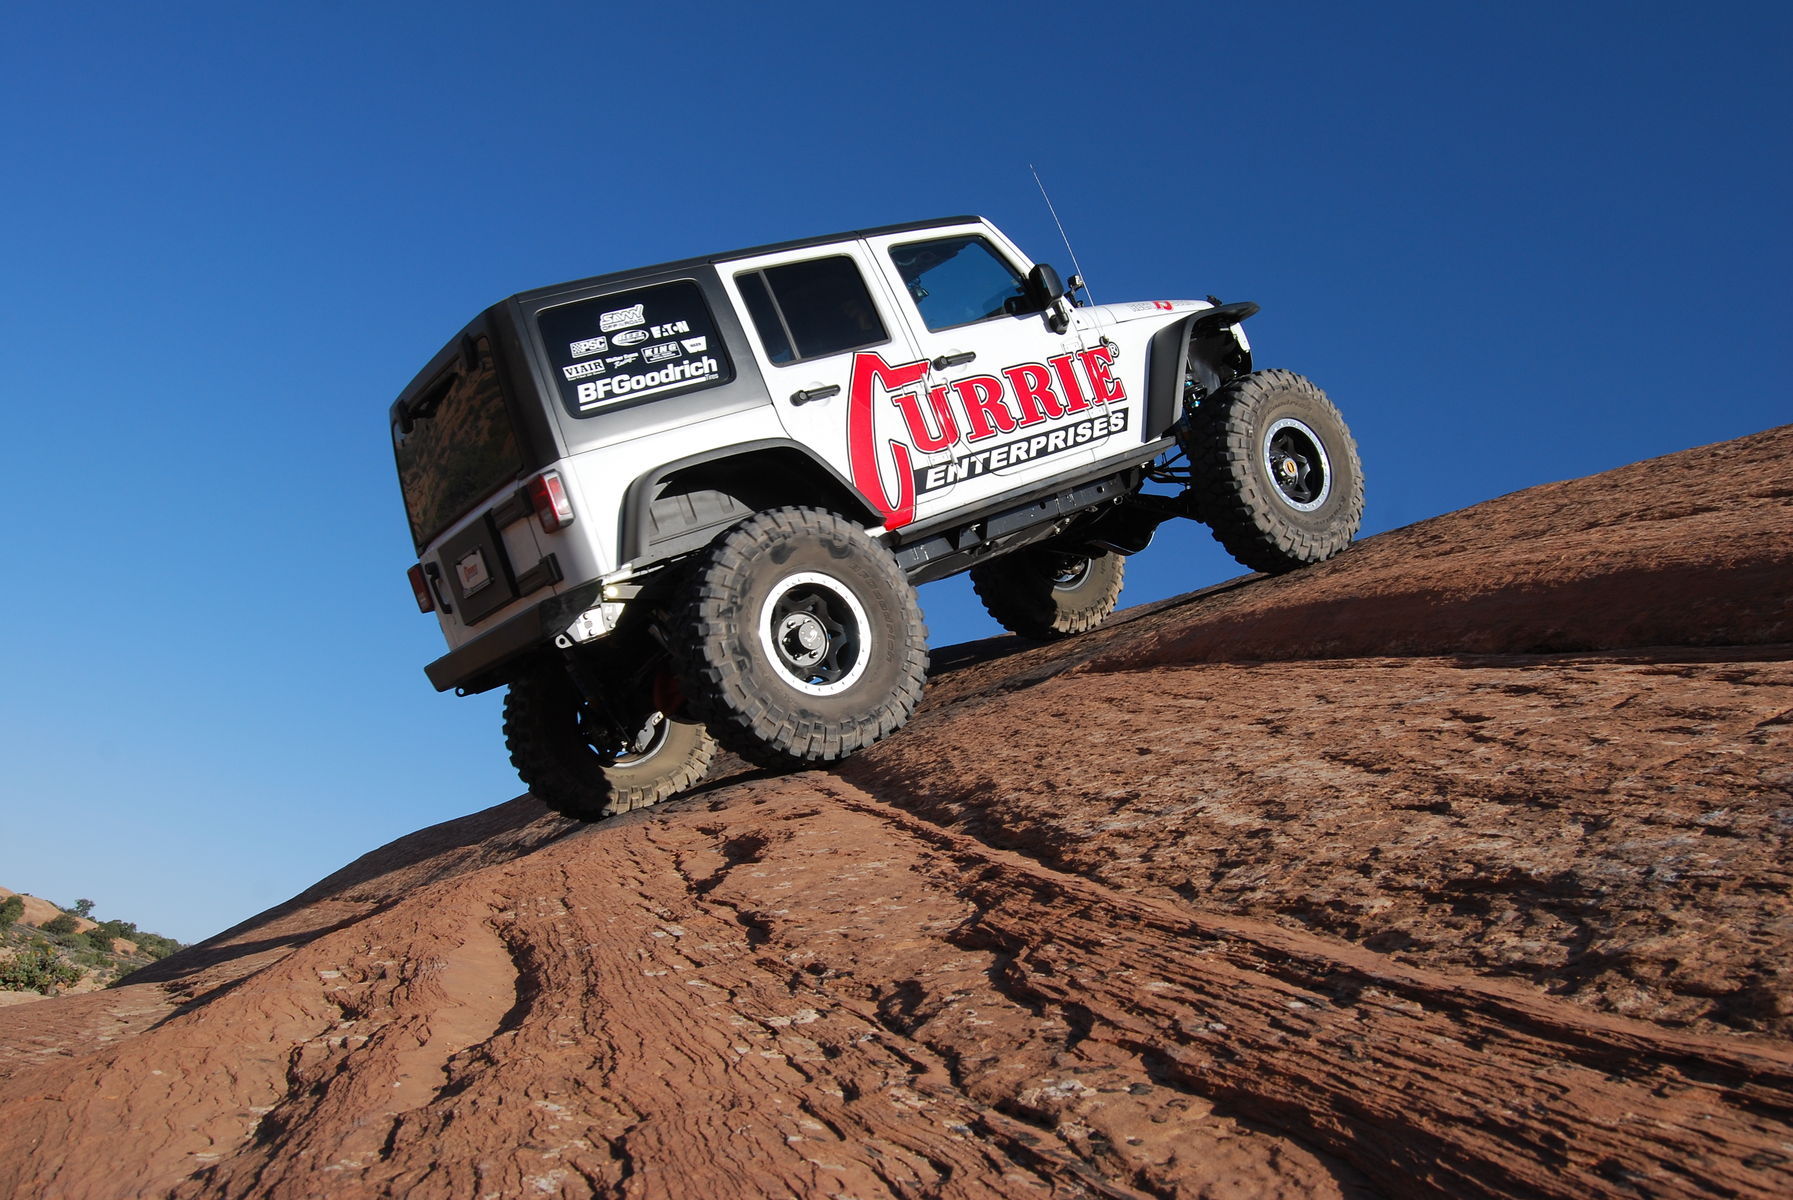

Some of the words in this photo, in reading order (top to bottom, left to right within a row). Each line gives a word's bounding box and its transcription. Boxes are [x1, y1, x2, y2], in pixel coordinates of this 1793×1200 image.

[650, 321, 689, 338] EATON
[580, 338, 606, 352] PSC
[644, 343, 679, 358] KING
[565, 361, 603, 376] VIAIR
[577, 356, 718, 403] BFGoodrich
[847, 346, 1128, 531] CURRIE
[925, 410, 1126, 490] ENTERPRISES
